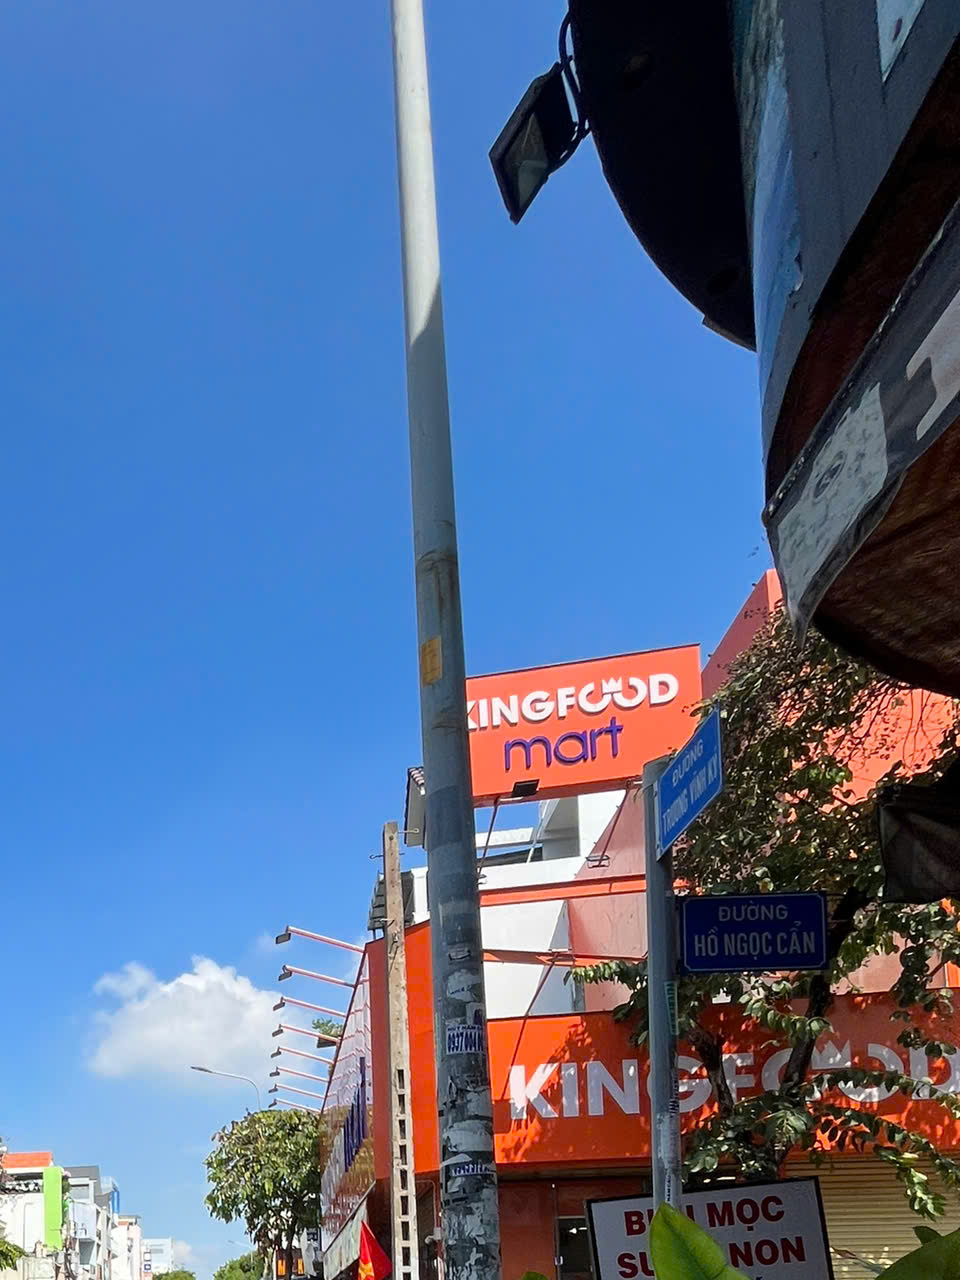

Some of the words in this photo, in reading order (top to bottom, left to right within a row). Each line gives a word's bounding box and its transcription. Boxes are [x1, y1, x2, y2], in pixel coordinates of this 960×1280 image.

[504, 716, 623, 771] mart
[718, 900, 788, 922] ĐƯỜNG
[694, 926, 719, 957] HỒ
[723, 931, 773, 961] NGỌC
[776, 920, 816, 954] CẨN
[706, 1195, 785, 1231] MỌC
[728, 1236, 807, 1268] NON
